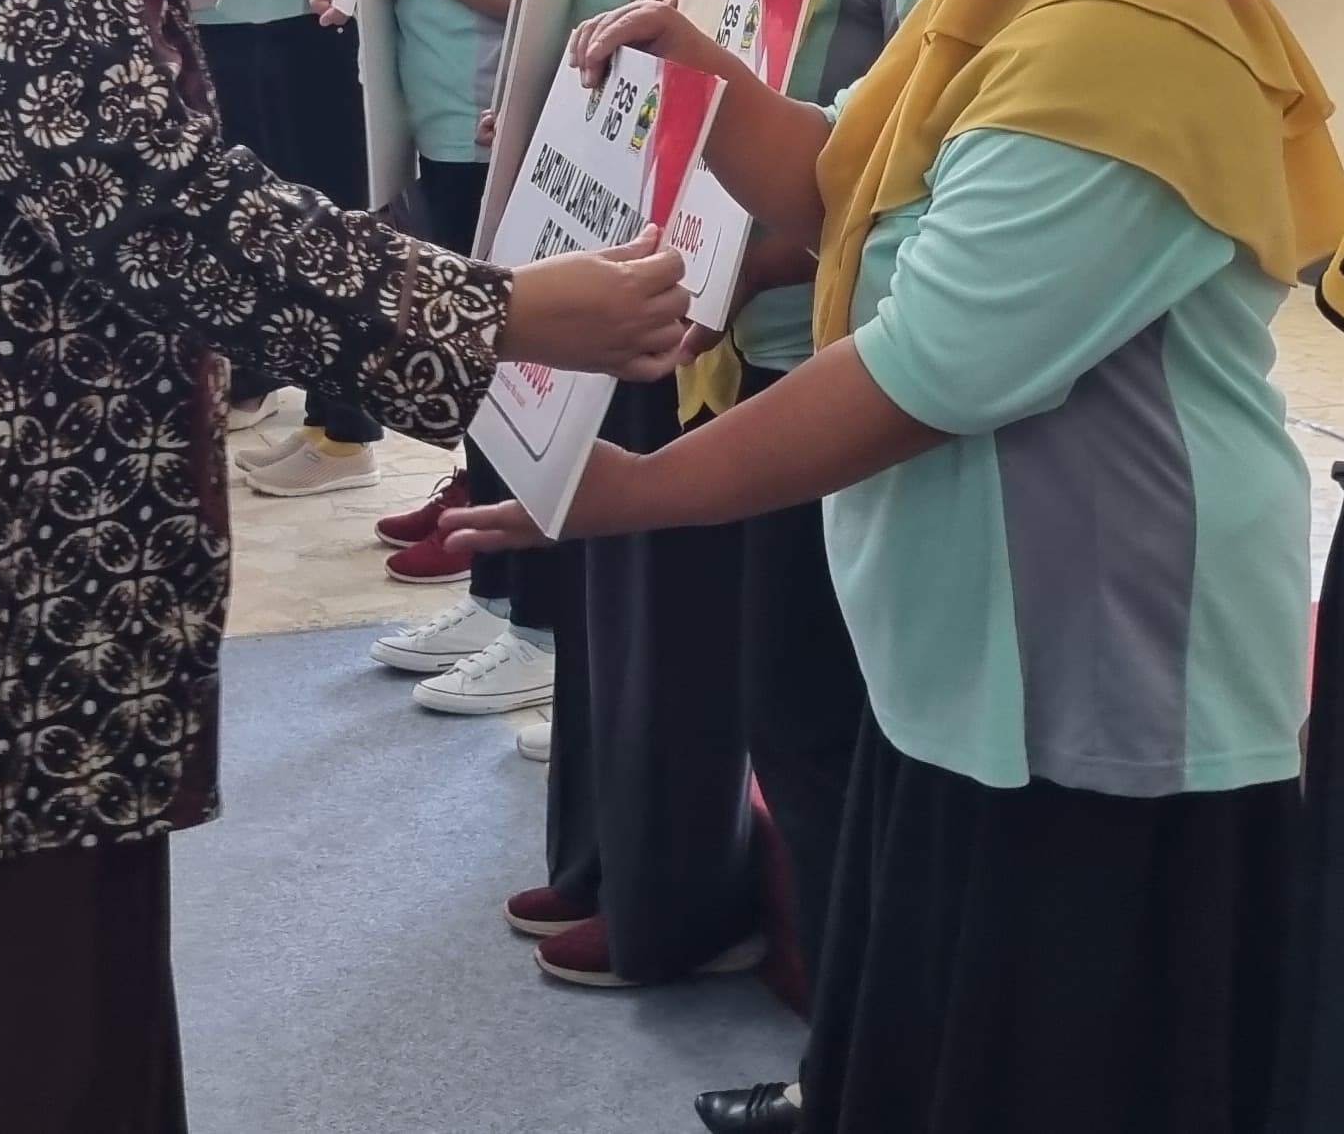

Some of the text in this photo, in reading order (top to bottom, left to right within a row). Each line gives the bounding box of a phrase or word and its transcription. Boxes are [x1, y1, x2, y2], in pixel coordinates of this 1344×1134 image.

[722, 4, 741, 28] OS
[611, 77, 638, 114] POS
[530, 143, 575, 206] BANTUAN
[565, 168, 621, 242] LANGSUNG
